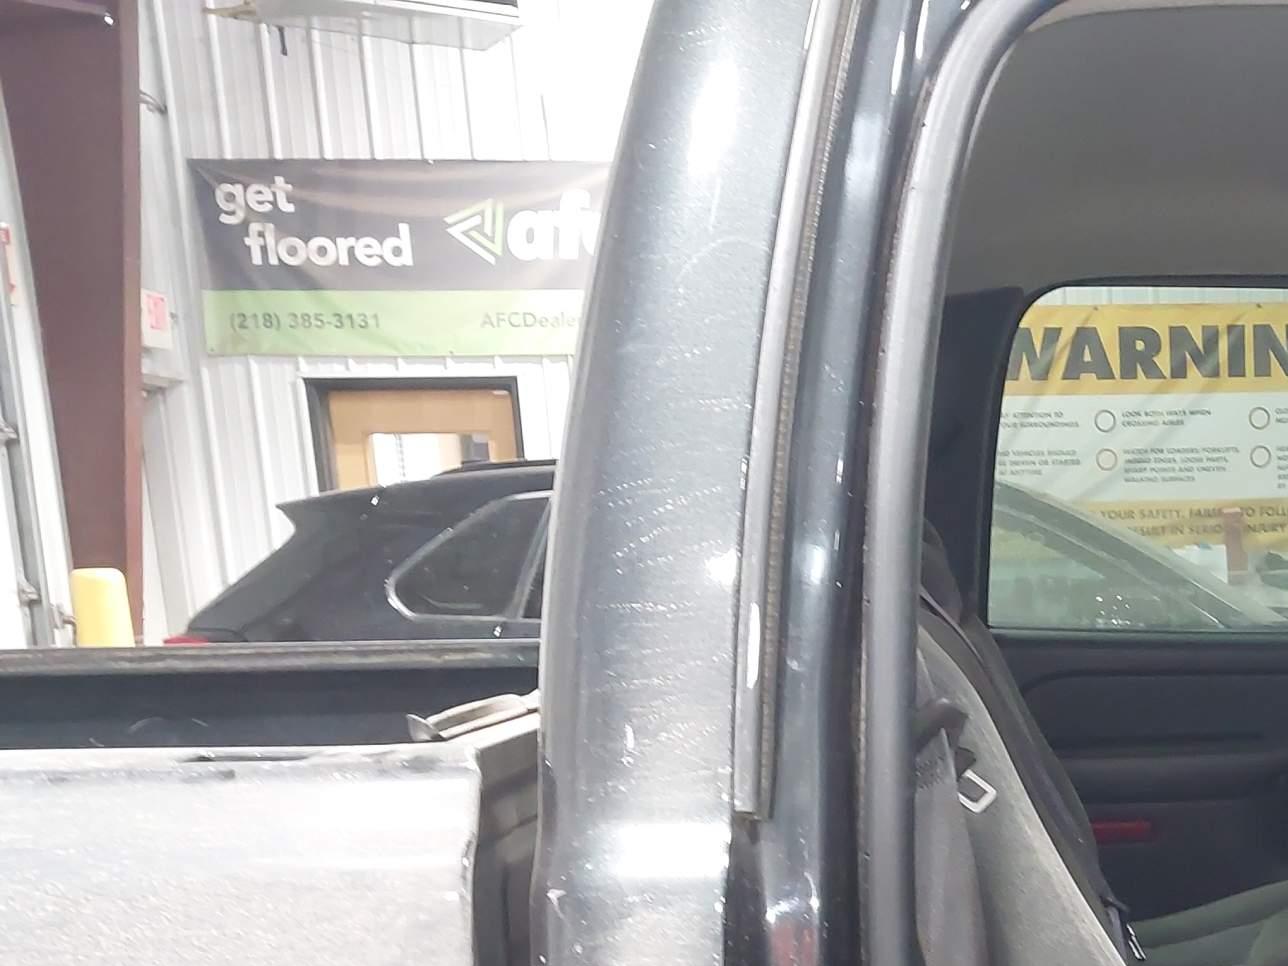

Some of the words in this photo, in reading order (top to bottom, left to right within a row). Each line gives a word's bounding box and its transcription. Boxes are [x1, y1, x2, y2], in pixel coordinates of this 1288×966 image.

[215, 176, 295, 224] get
[244, 223, 413, 266] floored
[230, 312, 281, 331] (218)
[288, 312, 379, 330] 385-3131
[1100, 509, 1135, 520] YOUR
